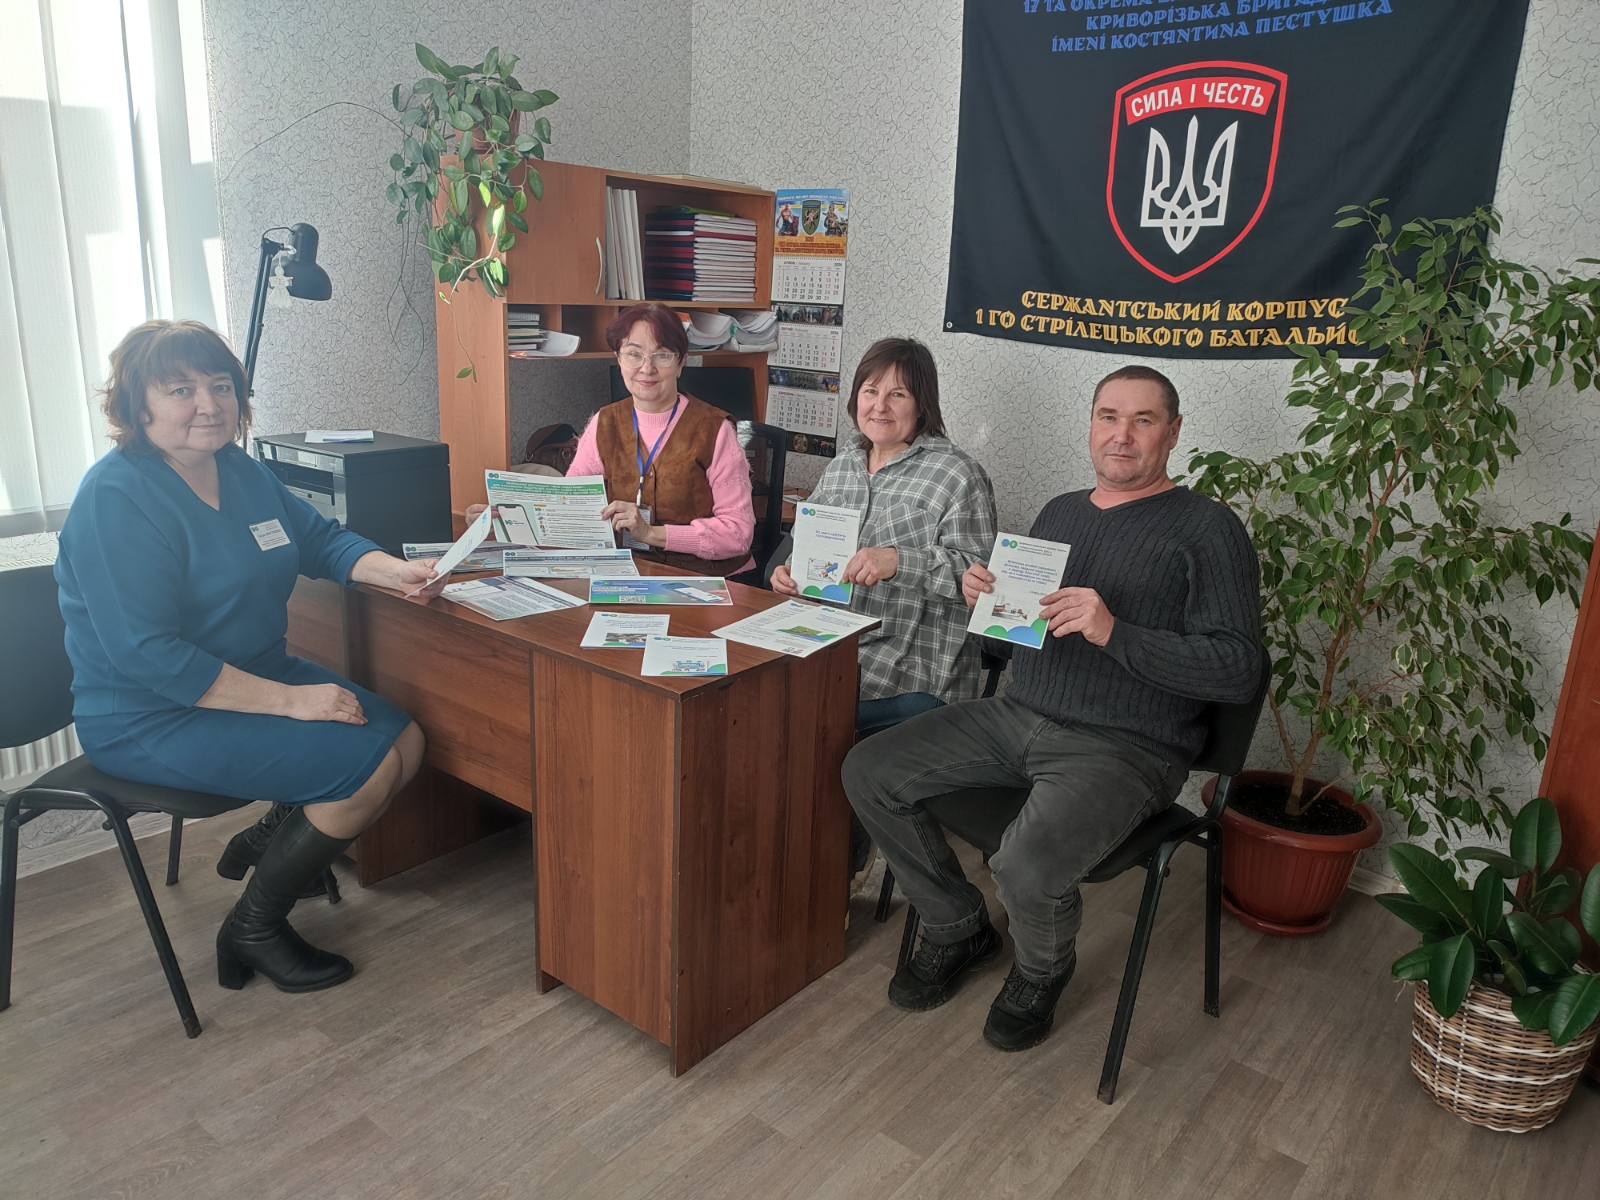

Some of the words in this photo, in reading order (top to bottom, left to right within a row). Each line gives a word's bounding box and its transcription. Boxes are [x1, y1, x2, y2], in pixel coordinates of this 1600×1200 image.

[1051, 34, 1107, 52] ІМЕНІ
[1110, 20, 1250, 49] КОСТЯНТИНА
[1255, 0, 1394, 34] ПЕСТУШКА
[1086, 2, 1231, 31] КРИВОРІЗЬКА
[1131, 86, 1183, 117] СИЛА
[1203, 82, 1265, 108] ЧЕСТЬ
[1021, 290, 1221, 322] СЕРЖАНТСЬКИЙ
[1226, 298, 1349, 322] КОРПУС
[975, 308, 984, 325] 1
[988, 309, 1016, 329] ГО
[1020, 314, 1204, 348] СТРІЛЕЦЬКОГО
[1209, 322, 1407, 347] БАТАЛЬЙ
